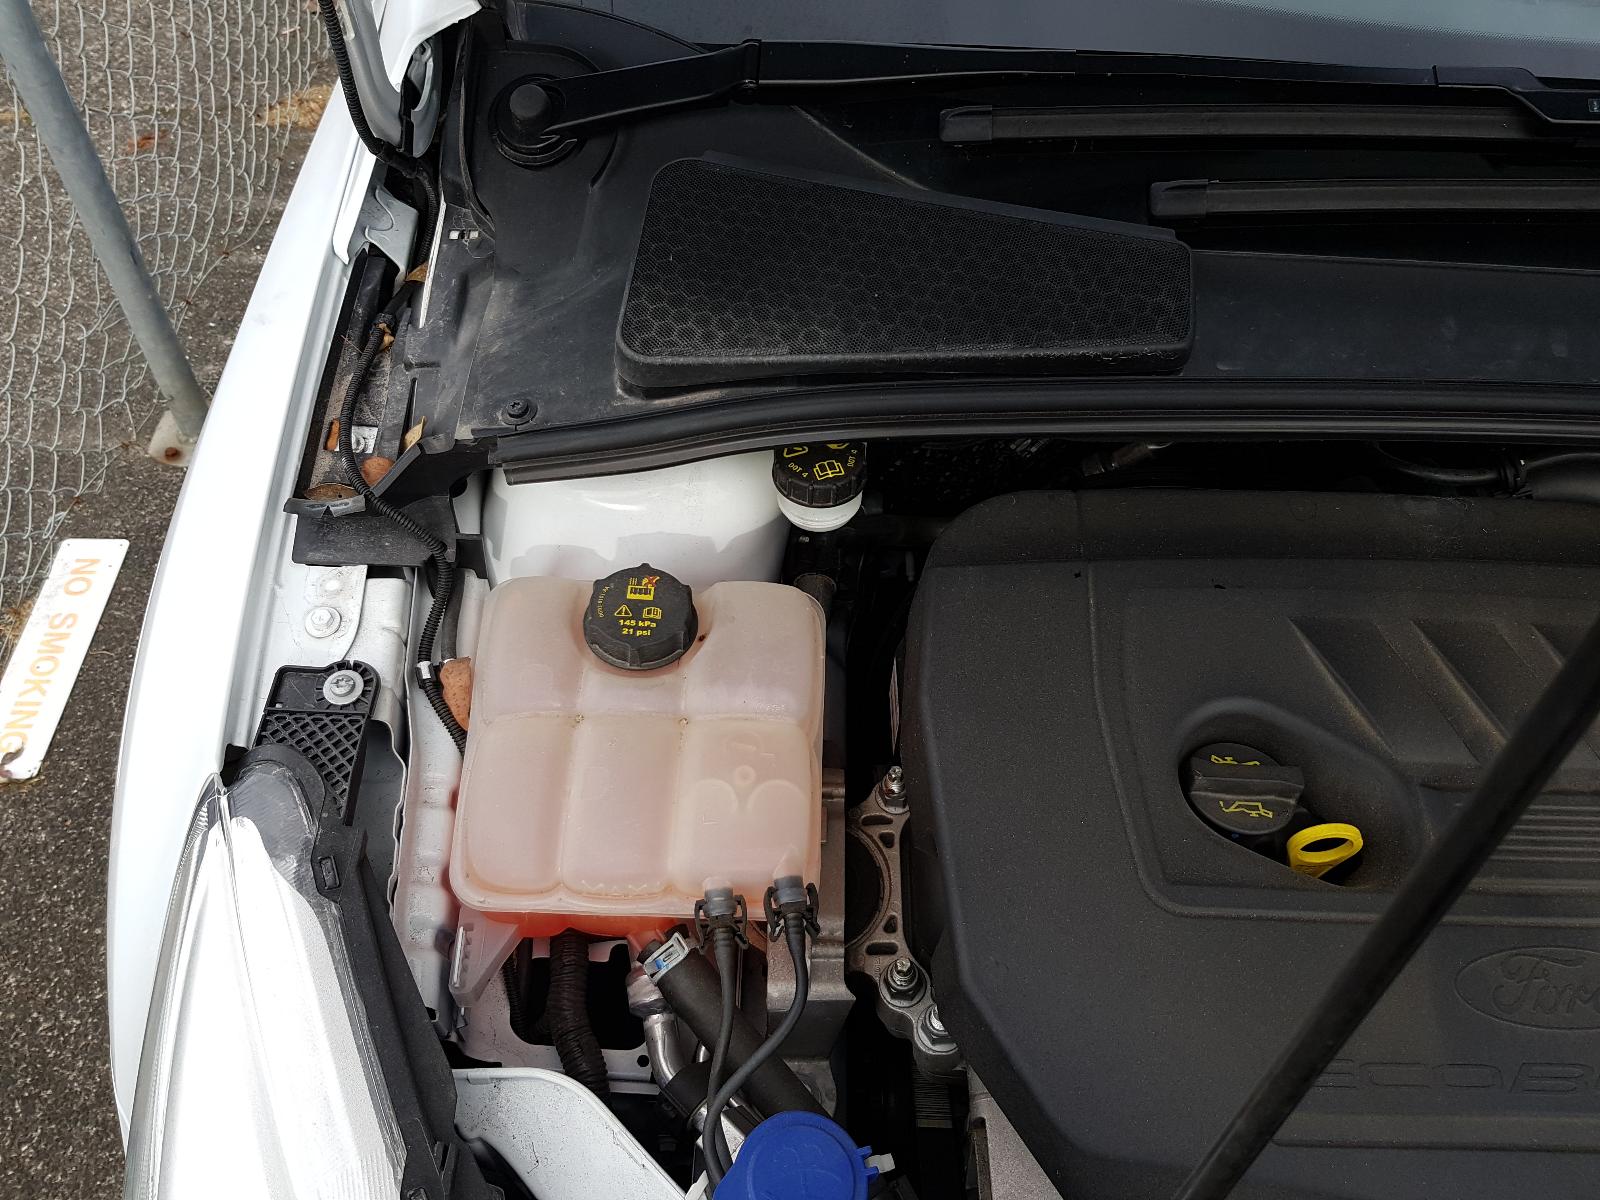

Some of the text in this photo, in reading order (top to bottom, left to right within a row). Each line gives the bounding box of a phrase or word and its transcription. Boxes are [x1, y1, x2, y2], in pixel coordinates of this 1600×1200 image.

[788, 462, 803, 473] DOT
[619, 619, 657, 628] 145 kPa
[636, 629, 651, 637] psi
[0, 558, 101, 753] NO SMOKING
